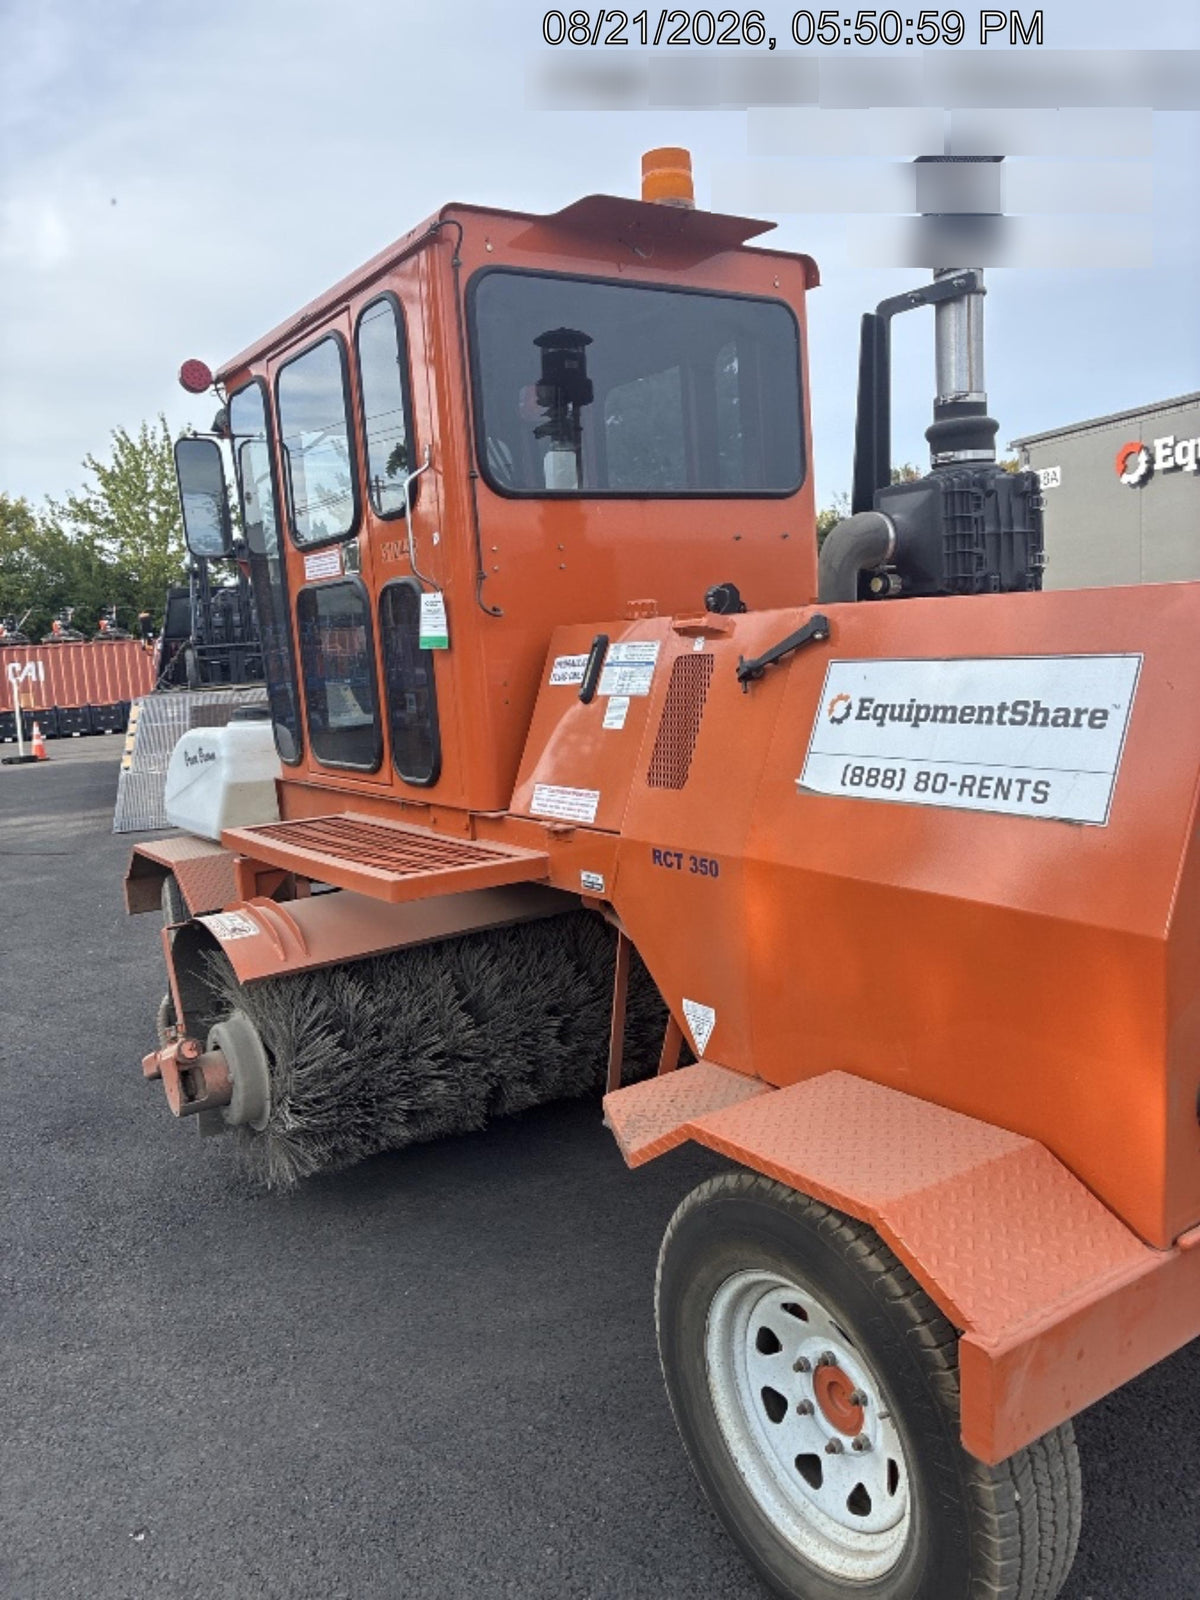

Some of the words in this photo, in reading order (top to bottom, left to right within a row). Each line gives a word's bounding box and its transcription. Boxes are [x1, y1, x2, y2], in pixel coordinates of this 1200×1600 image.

[1153, 435, 1200, 472] Eq
[7, 660, 45, 683] CAI
[854, 696, 1111, 730] EquipmentShare
[841, 763, 907, 793] (888)
[913, 771, 1052, 805] 80-RENTS
[652, 847, 684, 871] RCT
[689, 855, 720, 878] 350
